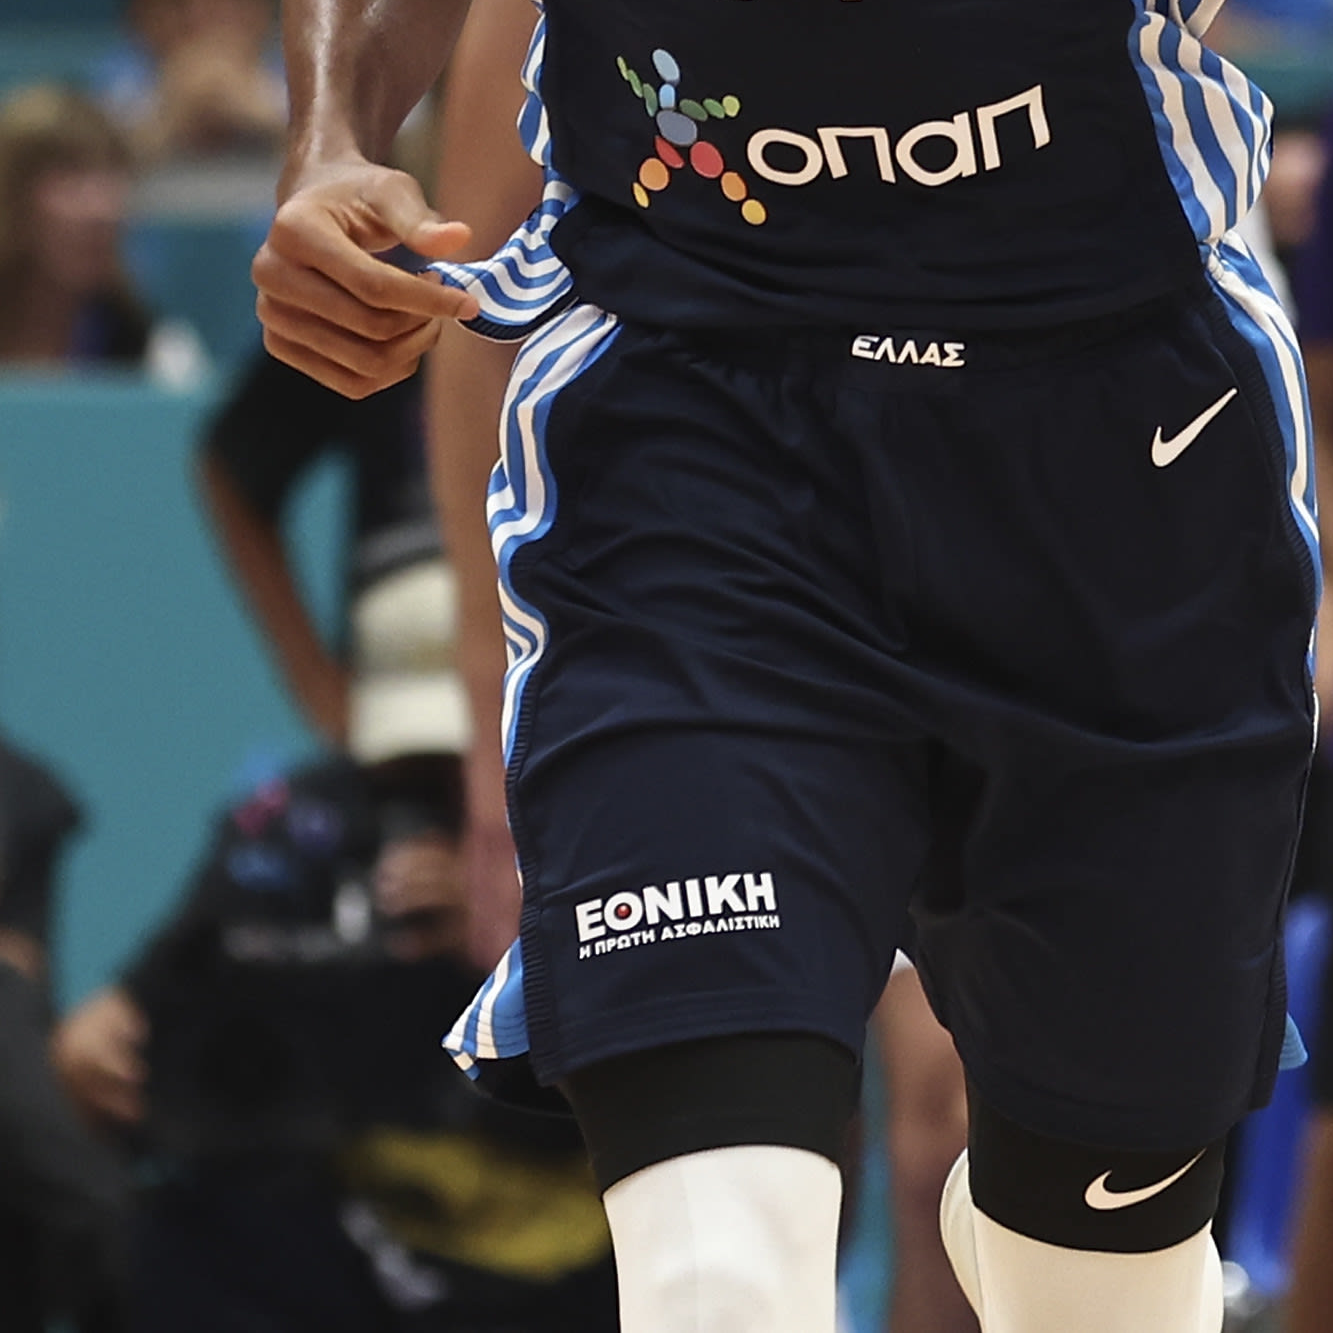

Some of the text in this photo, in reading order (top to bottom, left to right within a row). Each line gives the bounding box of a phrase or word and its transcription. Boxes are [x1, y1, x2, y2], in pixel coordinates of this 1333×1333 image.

[852, 335, 965, 367] ΕΛΛΑΣ
[579, 915, 780, 959] Η ΠΡΩΤΗ ΑΣΦΑΛΙΣΤΙΚΗ
